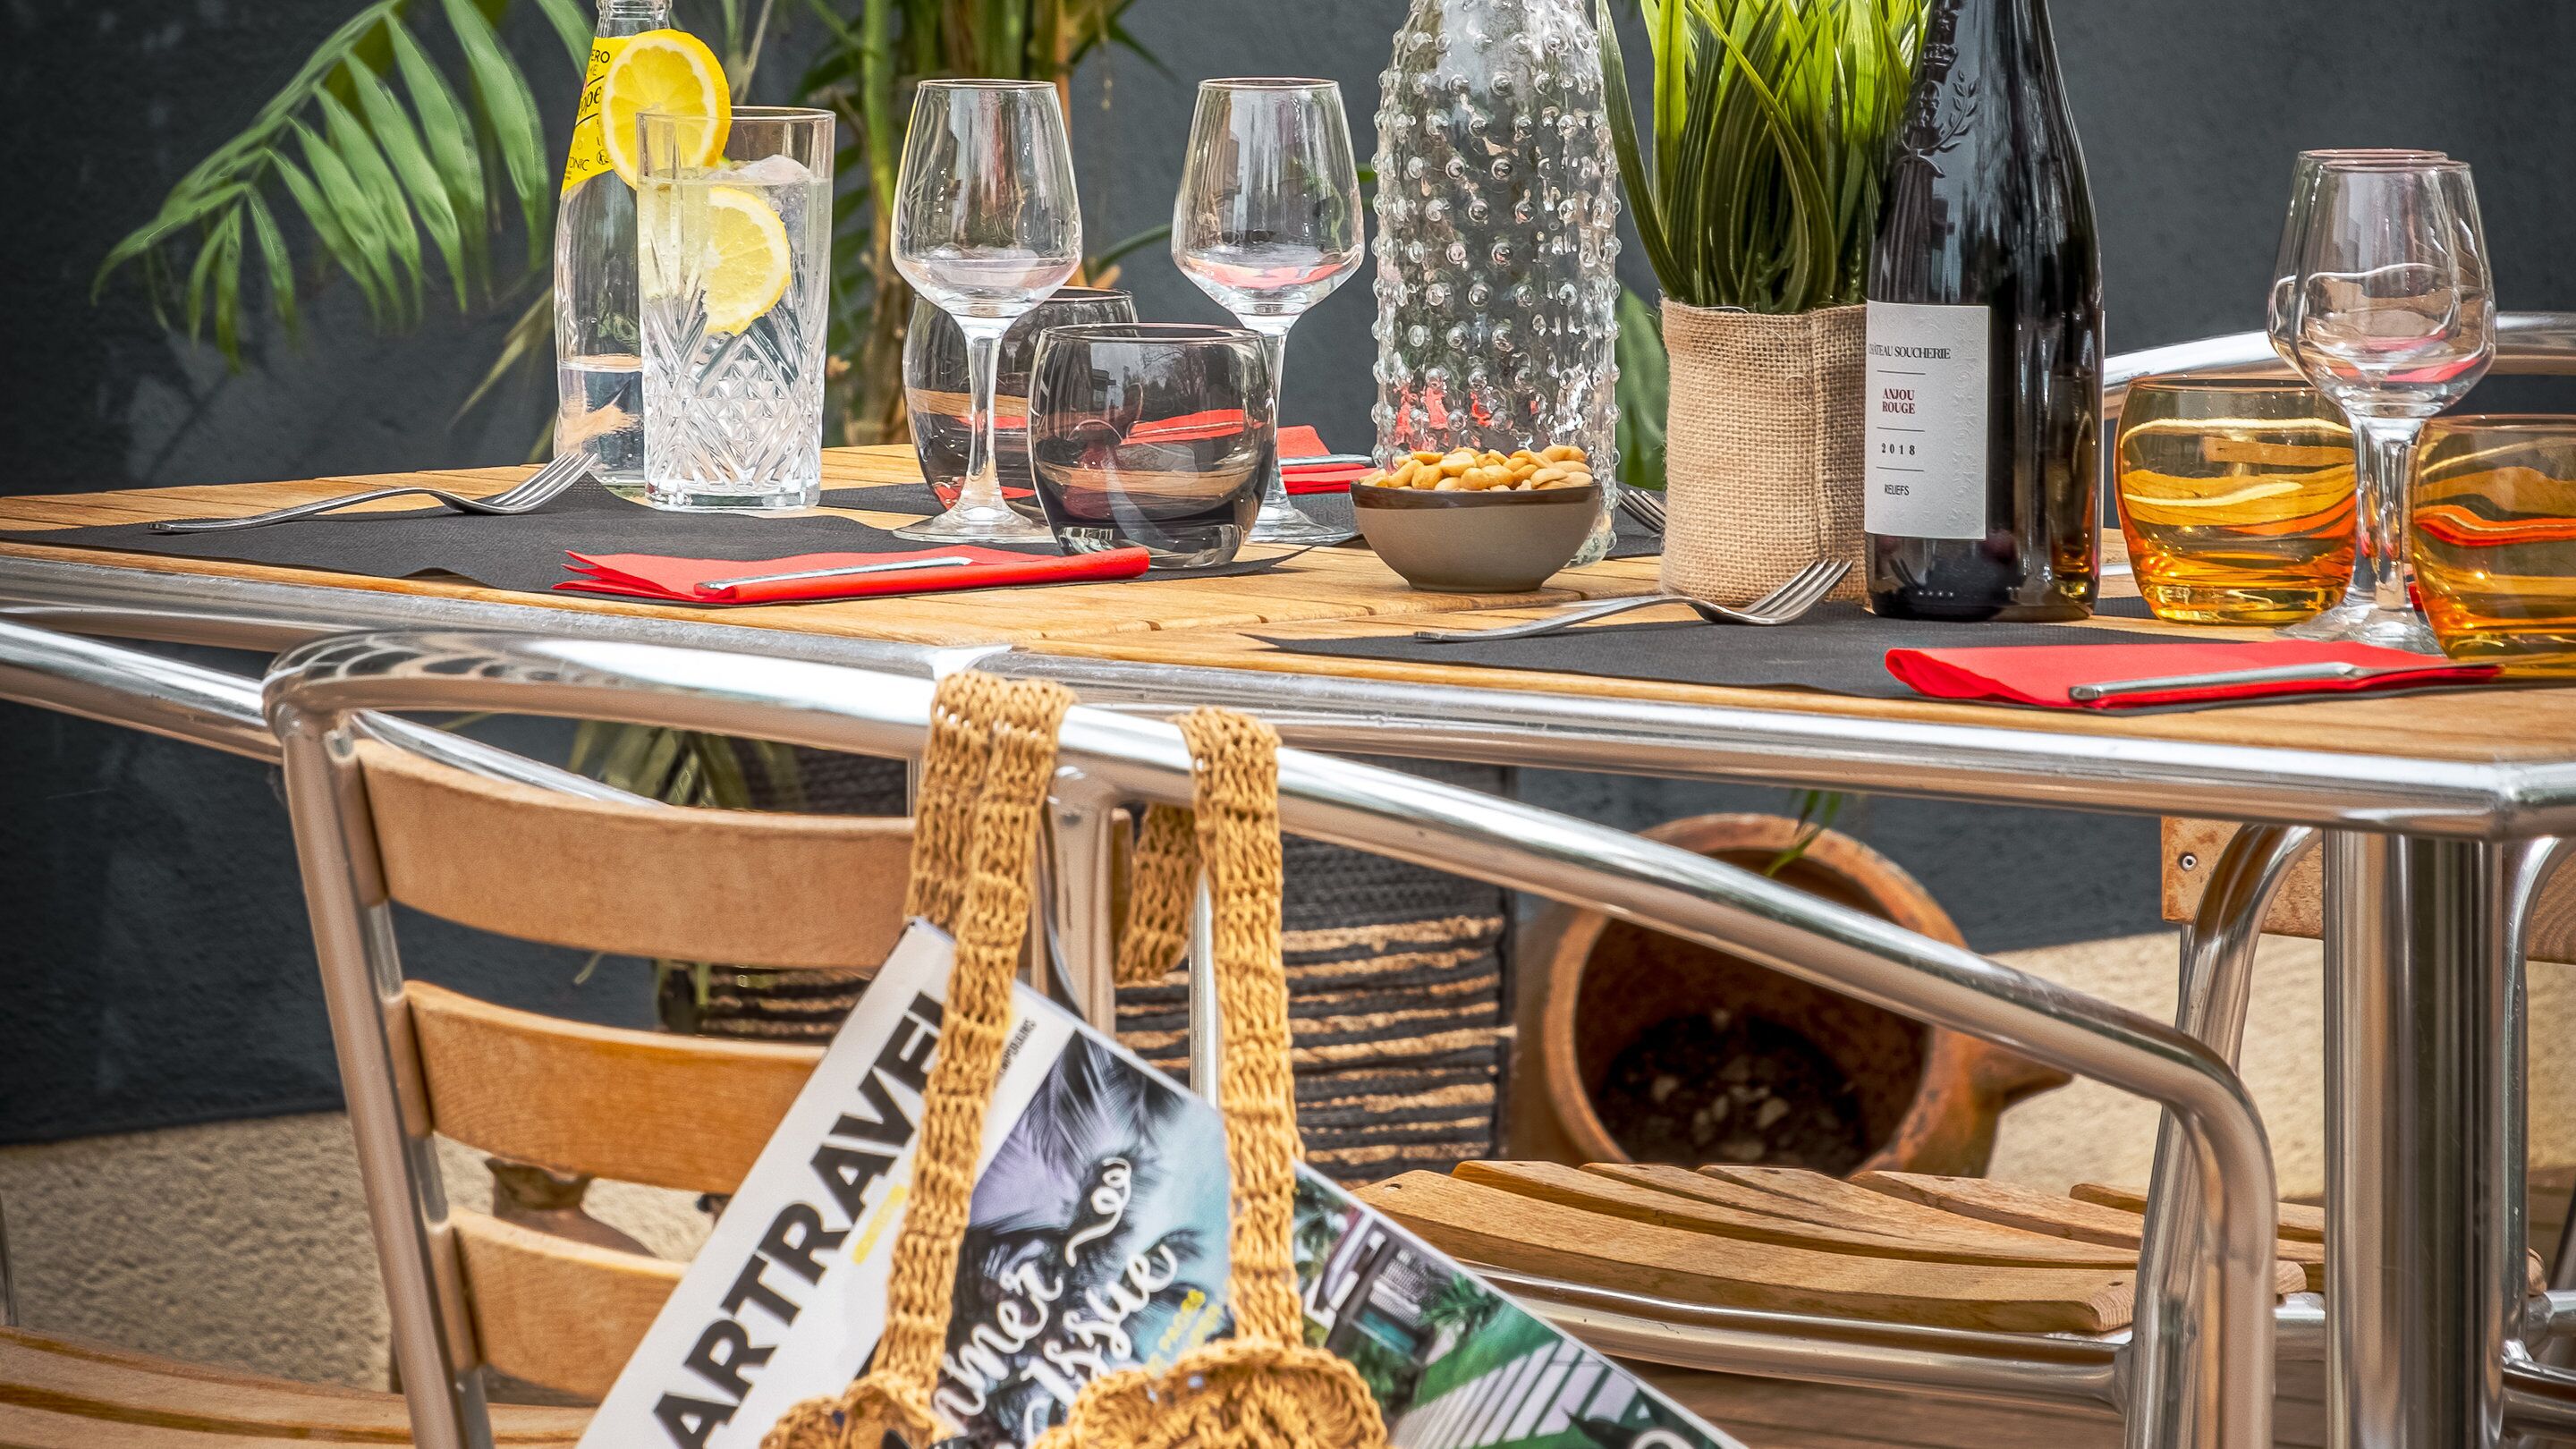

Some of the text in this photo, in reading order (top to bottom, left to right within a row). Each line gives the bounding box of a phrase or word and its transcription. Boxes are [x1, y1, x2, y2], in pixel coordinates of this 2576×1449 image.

[590, 49, 610, 64] ERO
[568, 156, 589, 172] ONIC
[1894, 345, 1952, 360] SOUCHERIE
[1883, 388, 1915, 401] ANJOU
[1882, 402, 1916, 414] ROUGE
[1881, 442, 1916, 455] 2018
